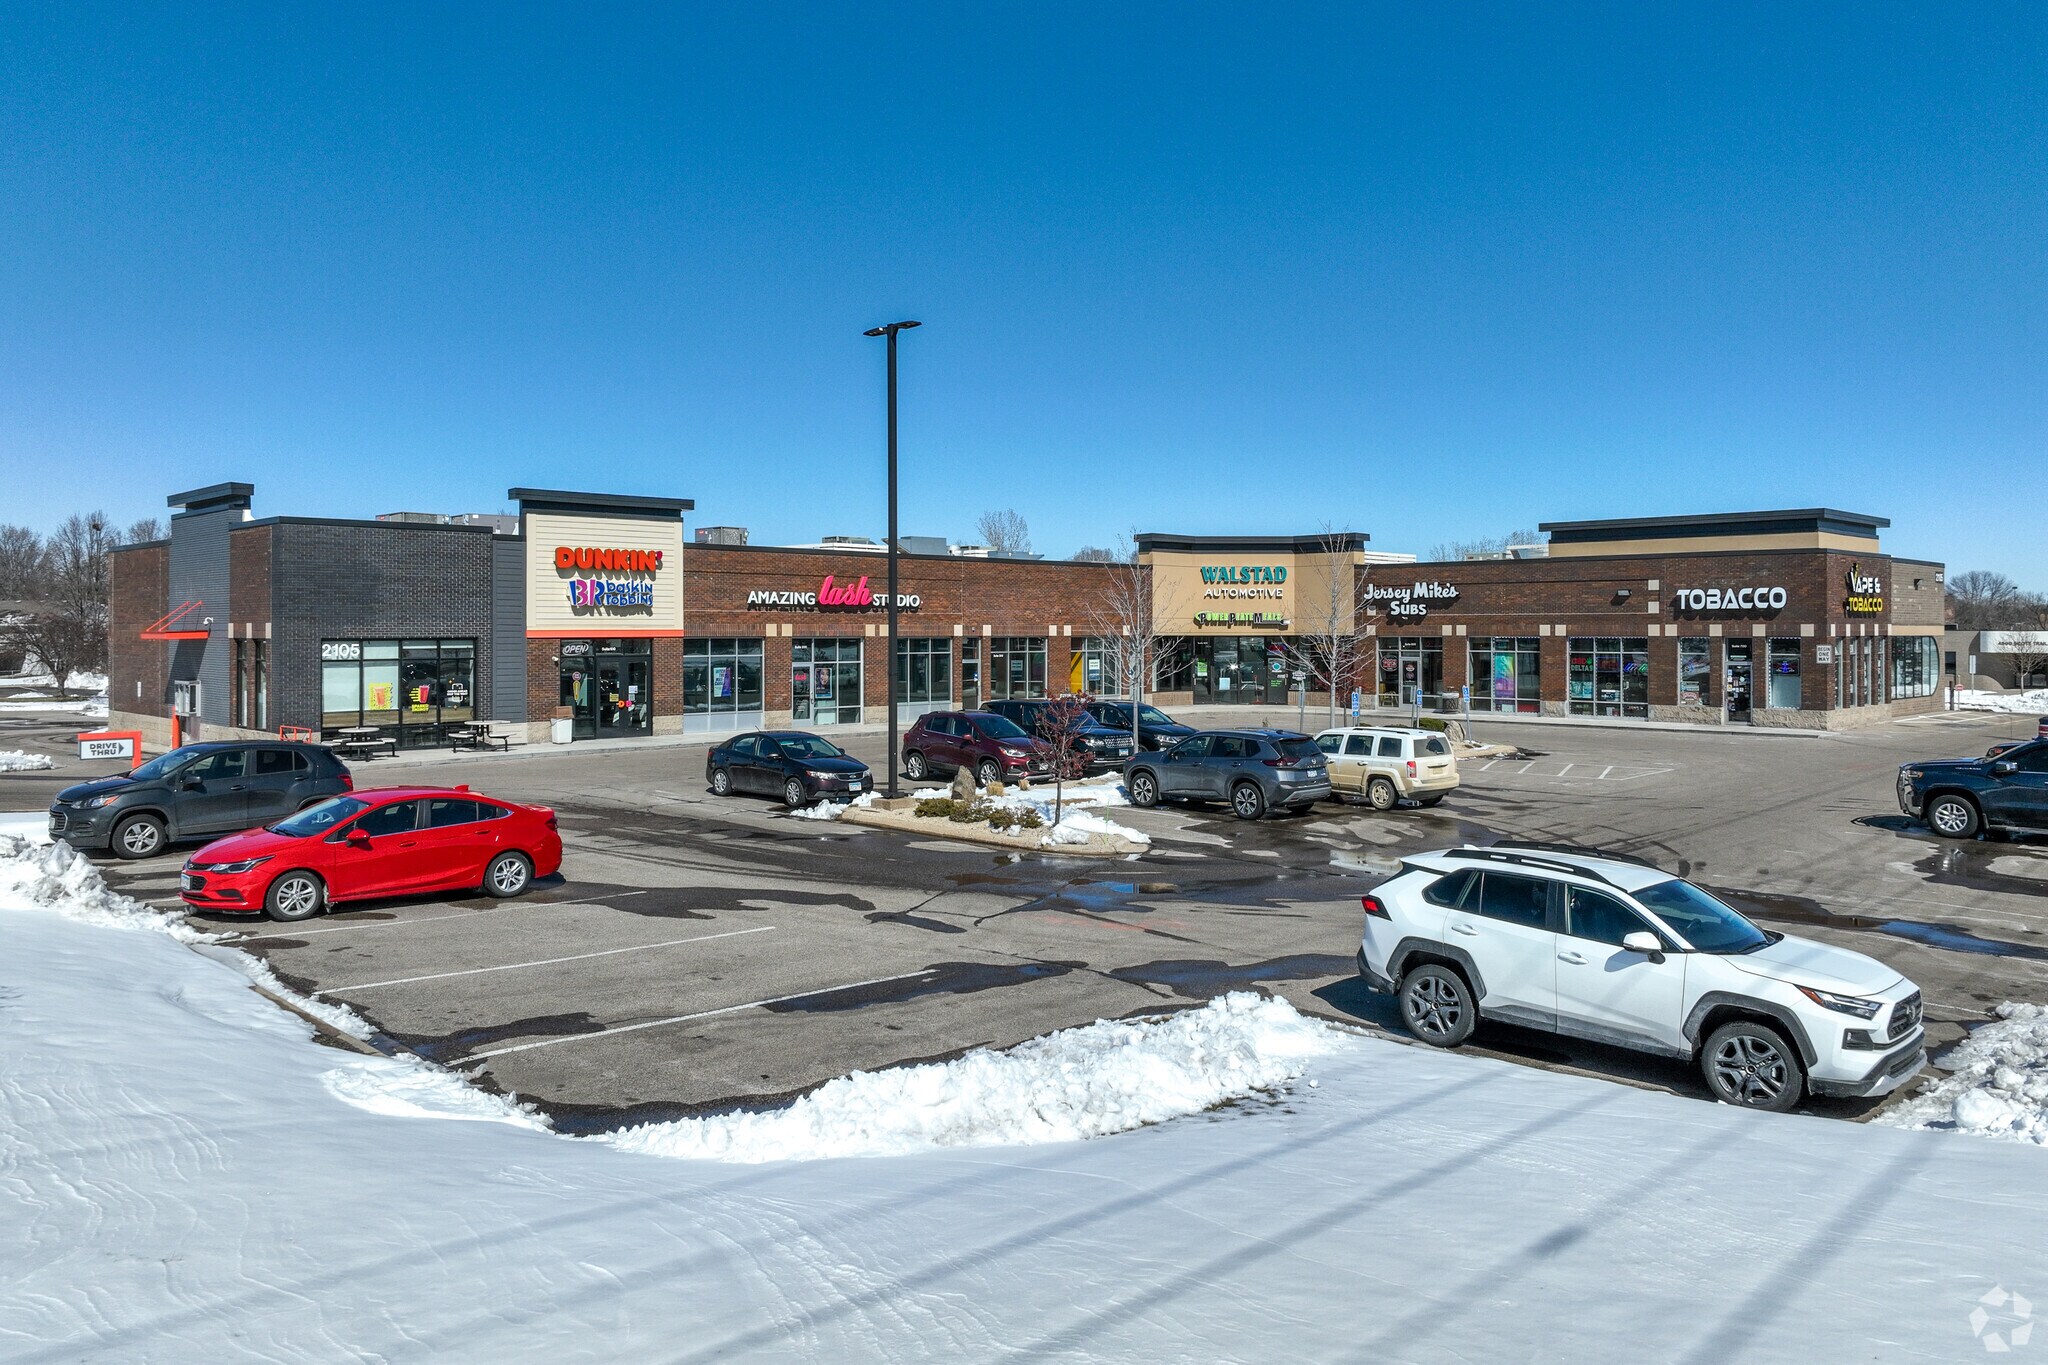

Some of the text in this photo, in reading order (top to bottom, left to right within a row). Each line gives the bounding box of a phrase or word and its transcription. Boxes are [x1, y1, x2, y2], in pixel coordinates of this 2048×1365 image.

[555, 547, 663, 571] DUNKIN'
[1201, 566, 1288, 582] WALSTAD
[1850, 568, 1881, 594] VAPE &
[606, 579, 653, 593] baskin
[747, 575, 921, 608] AMAZING lash STDIO
[1204, 588, 1284, 597] AUTOMOTIVE
[1363, 582, 1460, 604] Jersey Mike's
[606, 592, 653, 606] robbins
[1676, 587, 1787, 610] TOBACCO
[1848, 597, 1883, 612] TOBACCO
[322, 643, 360, 656] 2105
[564, 645, 586, 654] OPEN
